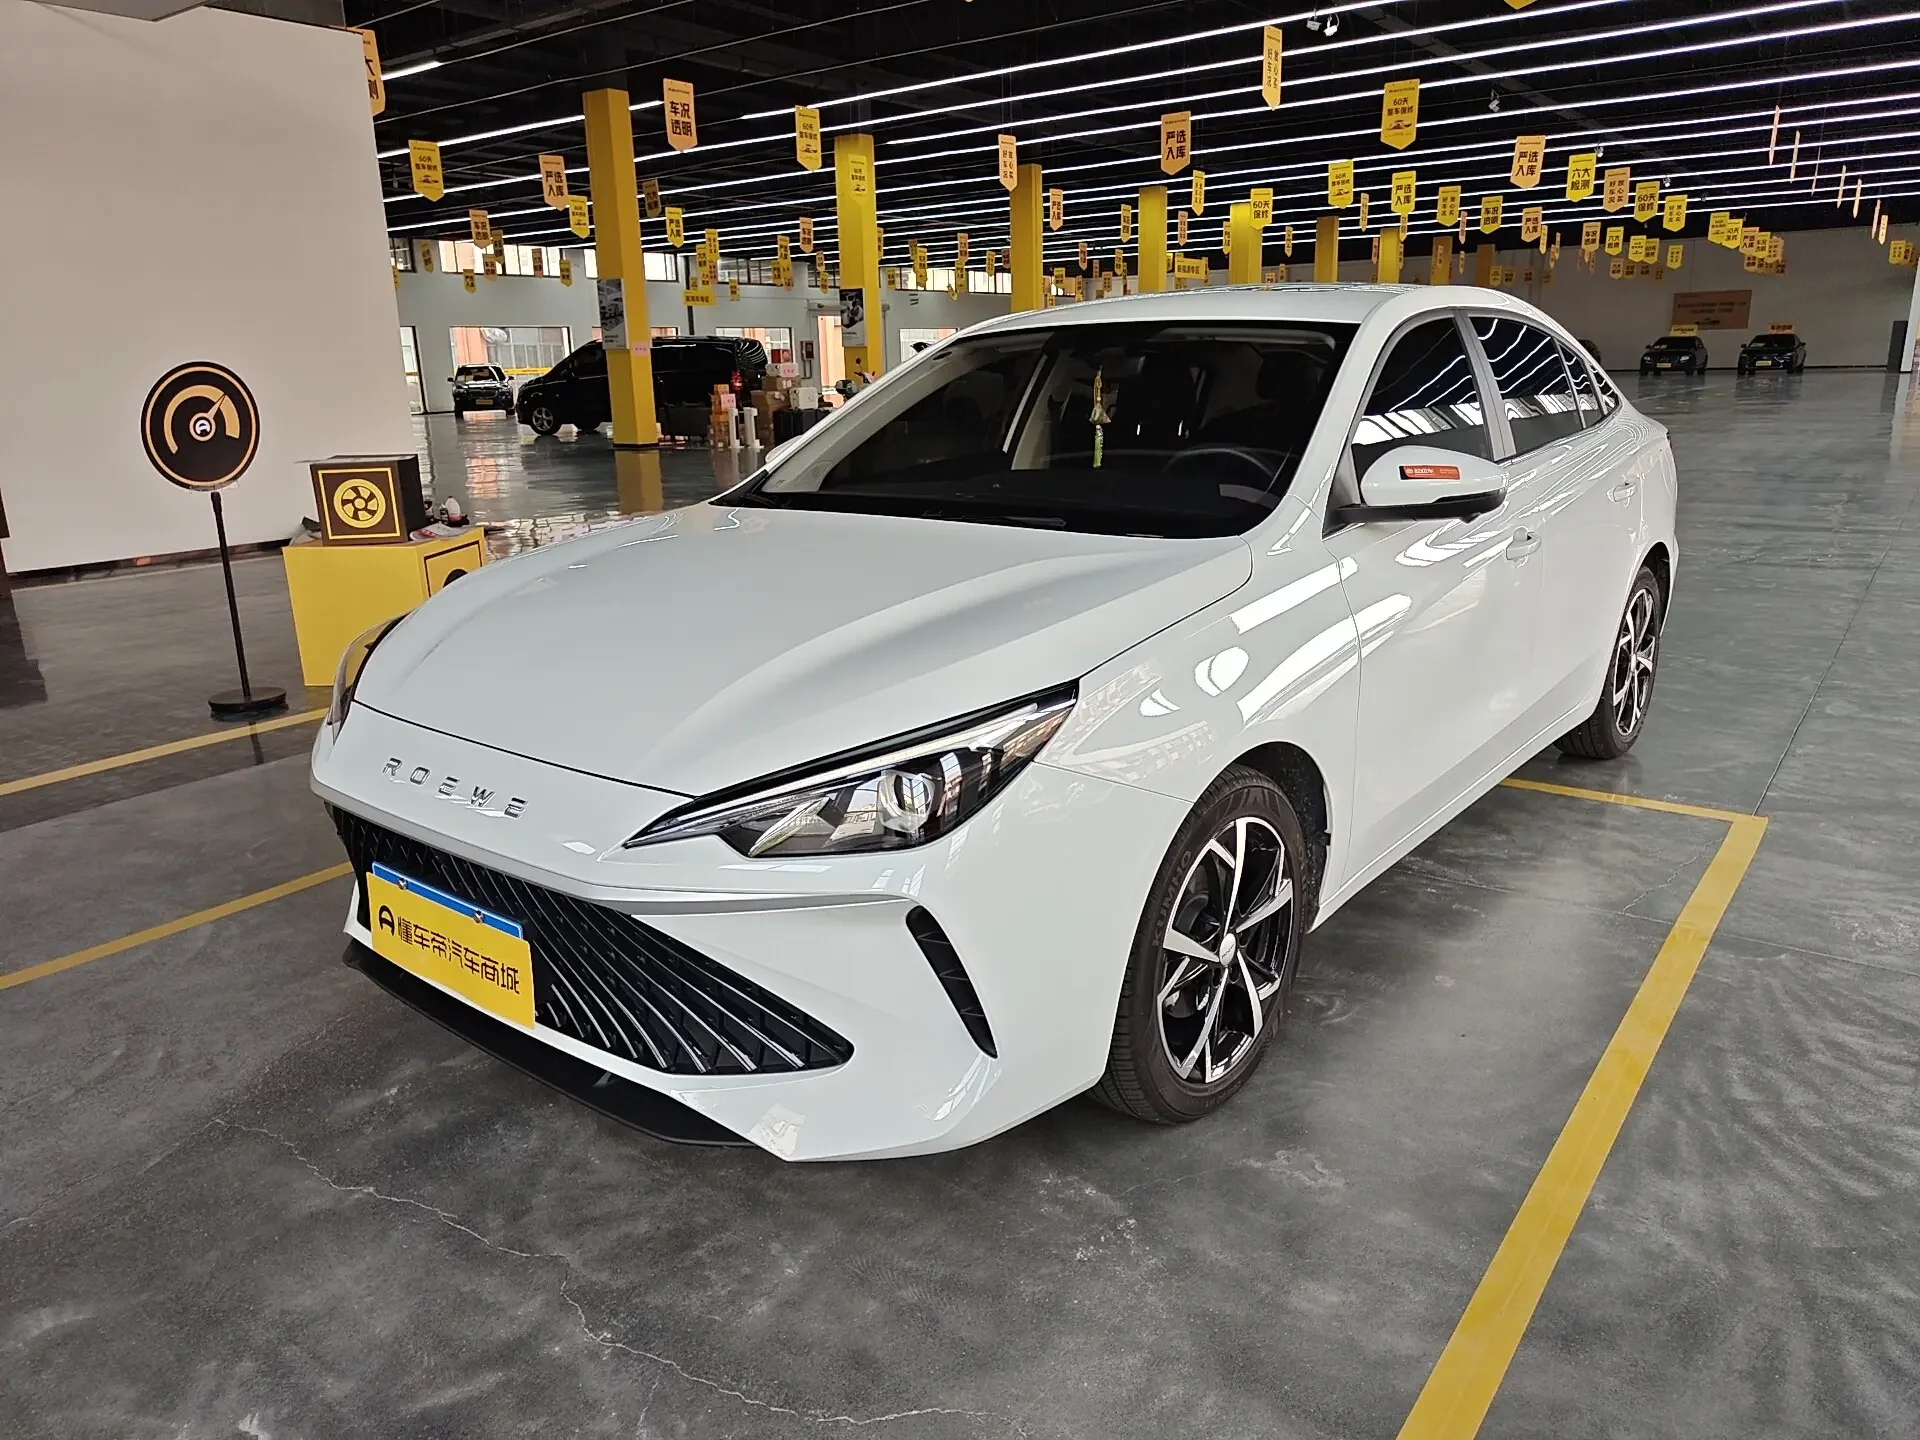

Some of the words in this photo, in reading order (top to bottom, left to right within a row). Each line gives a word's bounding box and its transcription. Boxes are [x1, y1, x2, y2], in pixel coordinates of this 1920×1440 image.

[1393, 97, 1408, 106] 60天
[669, 100, 691, 120] 车况
[1386, 106, 1414, 117] 整车保修
[670, 119, 693, 137] 透明
[1165, 130, 1186, 145] 严选
[1165, 146, 1186, 161] 入库
[1517, 151, 1539, 163] 严选
[1335, 172, 1347, 180] 60天
[1514, 164, 1537, 177] 入库
[1571, 168, 1591, 179] 六大
[545, 171, 564, 184] 严选
[547, 184, 565, 197] 入库
[1395, 184, 1412, 195] 严选
[1570, 179, 1590, 191] 检测
[1395, 195, 1412, 206] 入库
[1638, 193, 1656, 202] 60天
[1253, 200, 1270, 209] 60天
[1638, 202, 1655, 212] 保修
[1253, 209, 1269, 219] 保修
[1484, 207, 1499, 215] 车况
[1524, 217, 1538, 225] 严选
[1524, 225, 1538, 234] 入库
[382, 757, 529, 819] ROEWE
[1152, 850, 1192, 946] KUMHO
[397, 916, 522, 995] 懂车帝汽车商城
